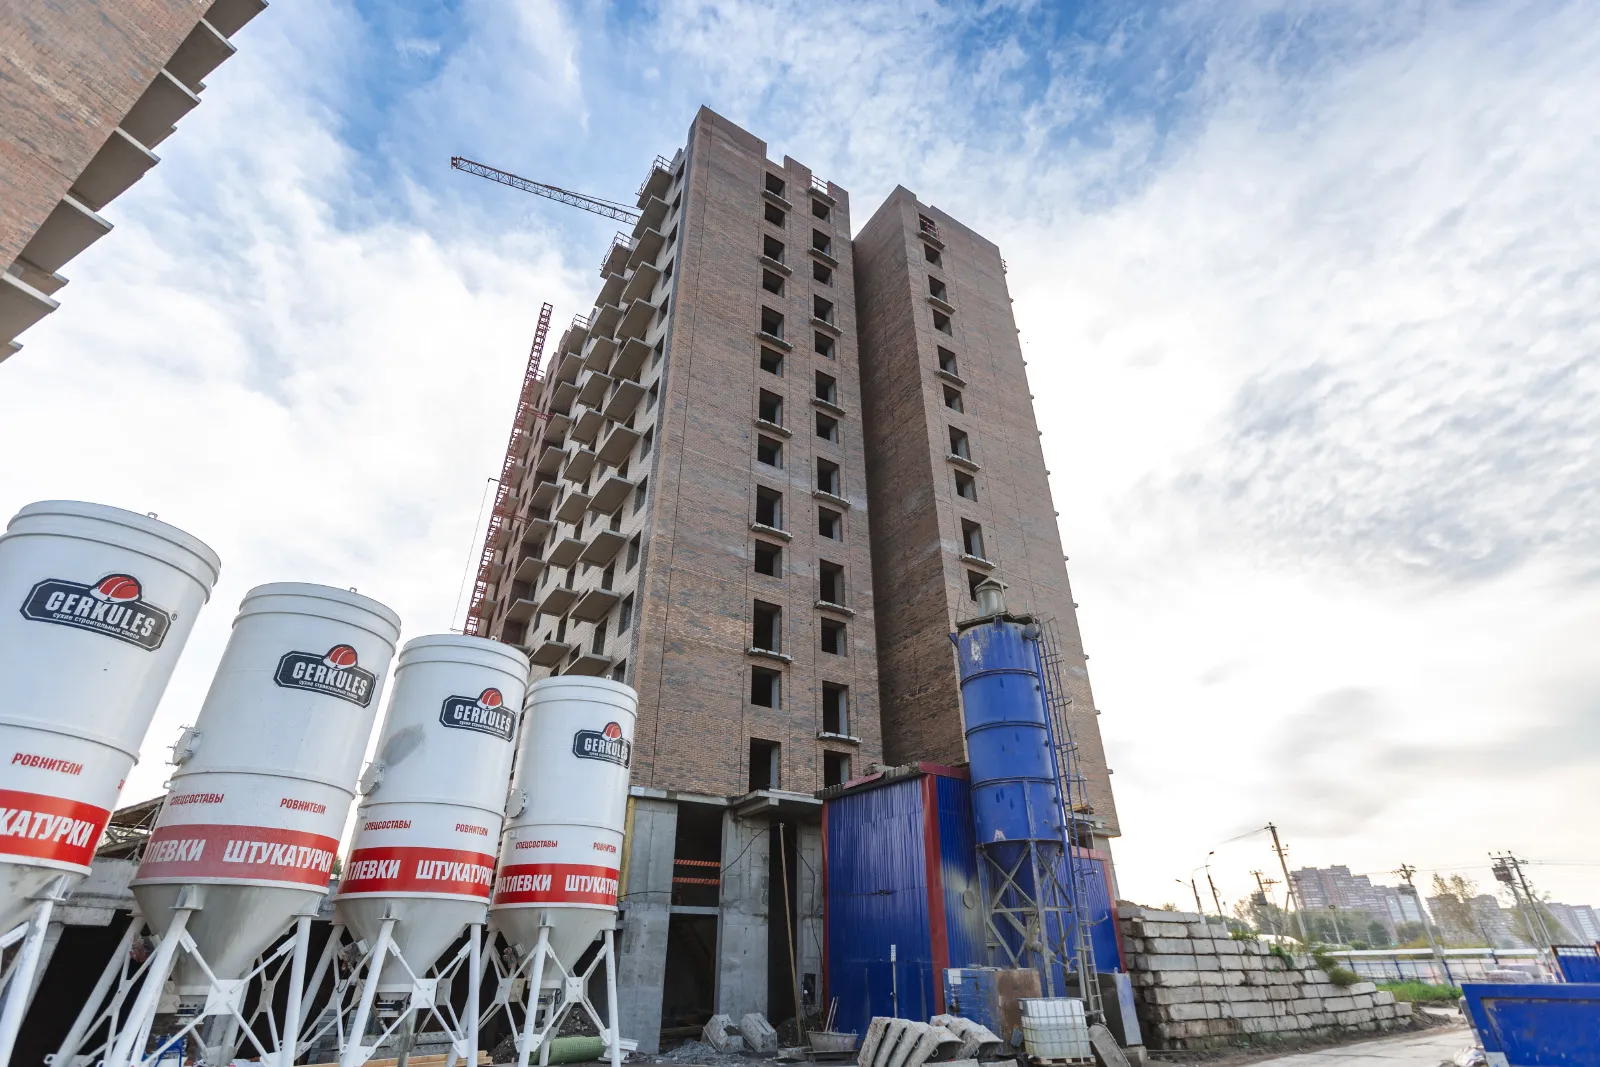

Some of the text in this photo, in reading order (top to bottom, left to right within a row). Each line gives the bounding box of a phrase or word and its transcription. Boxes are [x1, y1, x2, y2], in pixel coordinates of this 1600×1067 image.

[44, 591, 156, 637] GERKULES
[52, 612, 73, 621] сухие
[74, 616, 121, 634] строительные
[292, 661, 368, 697] GERKULES
[453, 704, 511, 732] GERKULES
[584, 737, 628, 760] GERKULES
[11, 752, 84, 776] РОВНИТЕЛИ
[169, 793, 327, 815] СПЕЦСОСТАВЫ РОВНИТЕЛИ
[0, 807, 95, 848] КАТУРКИ
[363, 820, 412, 831] СПЕЦСОСТАВЫ
[222, 839, 334, 873] ШТУКАТУРКИ
[515, 840, 558, 849] СПЕЦСОСТАВЫ
